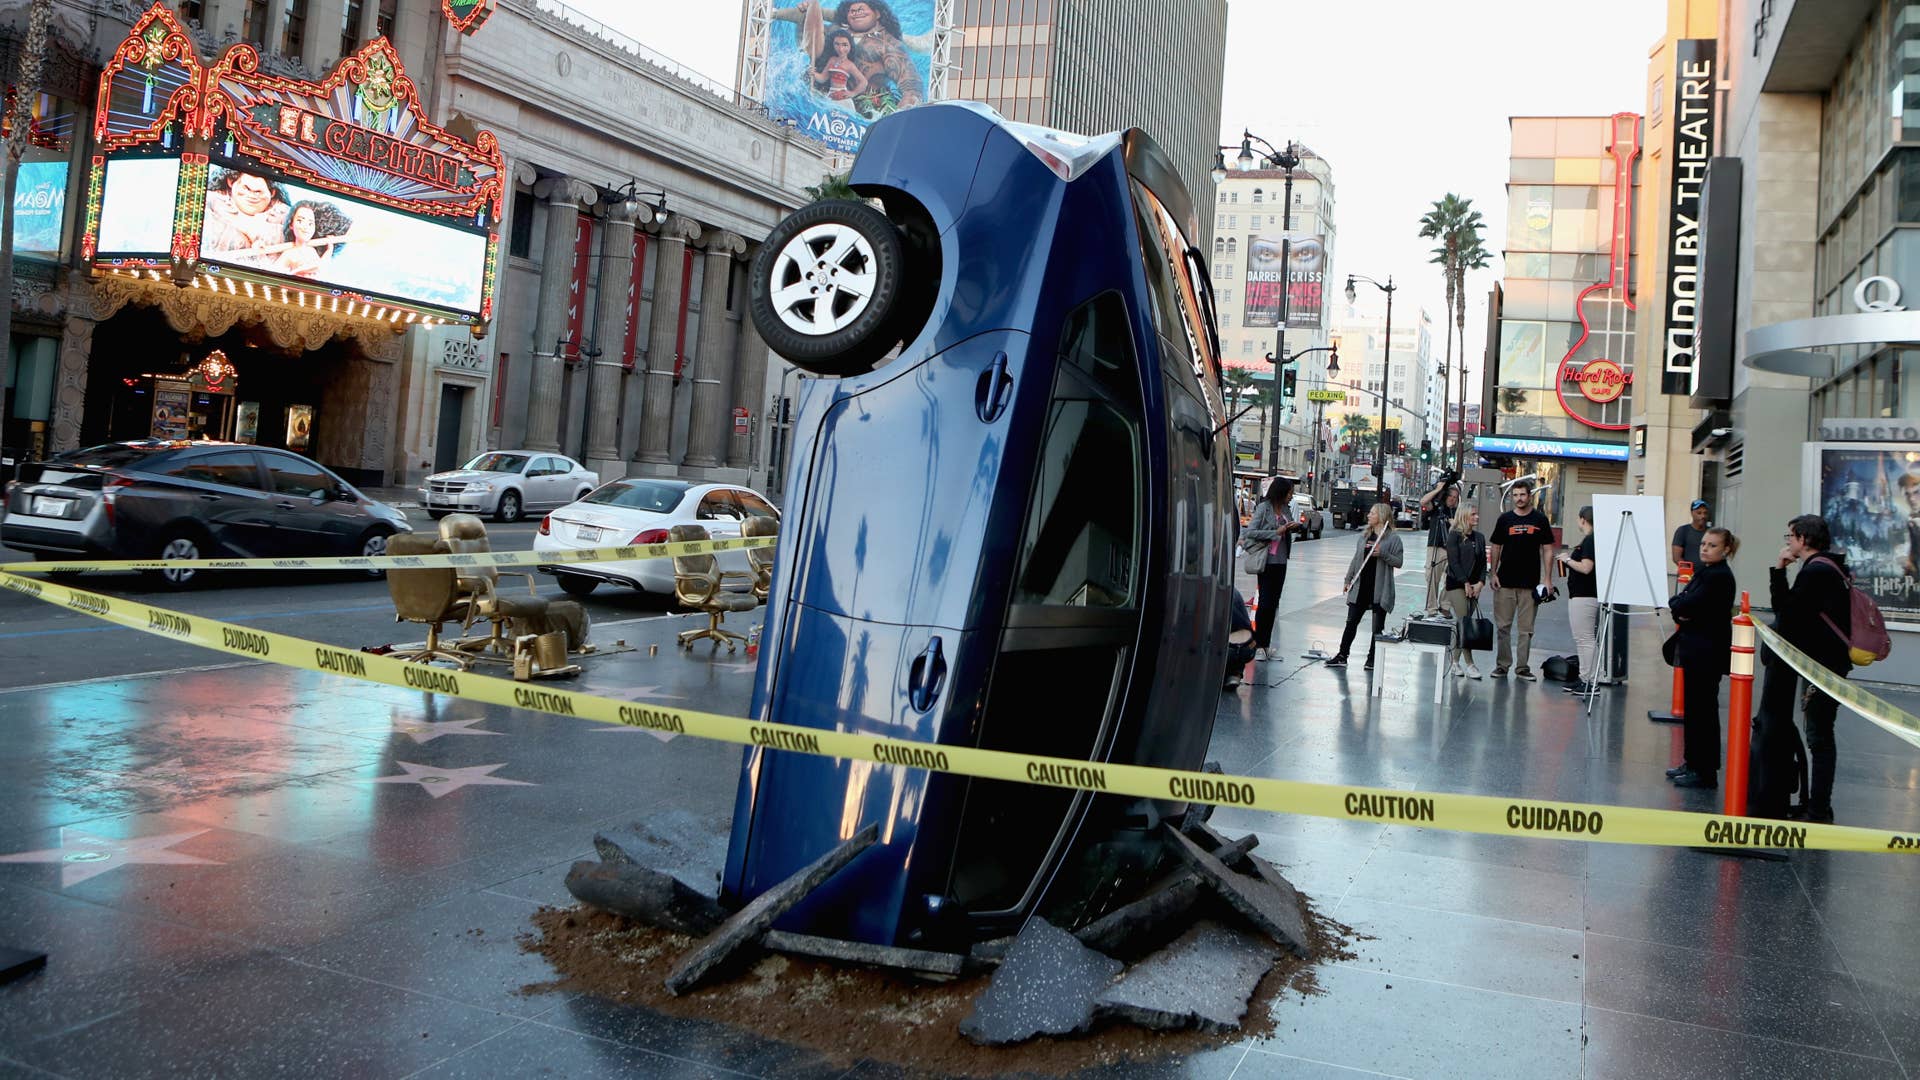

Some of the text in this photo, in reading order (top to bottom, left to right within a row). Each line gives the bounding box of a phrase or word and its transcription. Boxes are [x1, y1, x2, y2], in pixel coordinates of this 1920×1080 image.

[806, 111, 867, 140] MOAN
[1678, 60, 1710, 205] THEATRE
[279, 106, 459, 187] EL CAPITAN
[822, 134, 859, 147] NOVEMBER
[1247, 271, 1322, 282] DARREN CRISS
[1854, 275, 1906, 312] Q
[1564, 368, 1602, 382] Hard
[1310, 391, 1324, 399] PED
[1513, 440, 1563, 455] MOANA
[1570, 447, 1593, 455] WORLD
[1874, 576, 1905, 596] Harry
[148, 610, 192, 638] CAUTION
[222, 627, 270, 655] CUIDADO
[316, 648, 367, 676] CAUTION
[403, 665, 459, 695] CUIDADO
[513, 687, 576, 715] CAUTION
[619, 706, 684, 733] CUIDADO
[750, 726, 821, 753] CAUTION
[873, 742, 950, 771] CUIDADO
[1026, 762, 1107, 790] CAUTION
[1169, 776, 1255, 805] CUIDADO
[1344, 792, 1435, 822] CAUTION
[1506, 805, 1603, 835] CUIDADO
[1704, 820, 1807, 849] CAUTION
